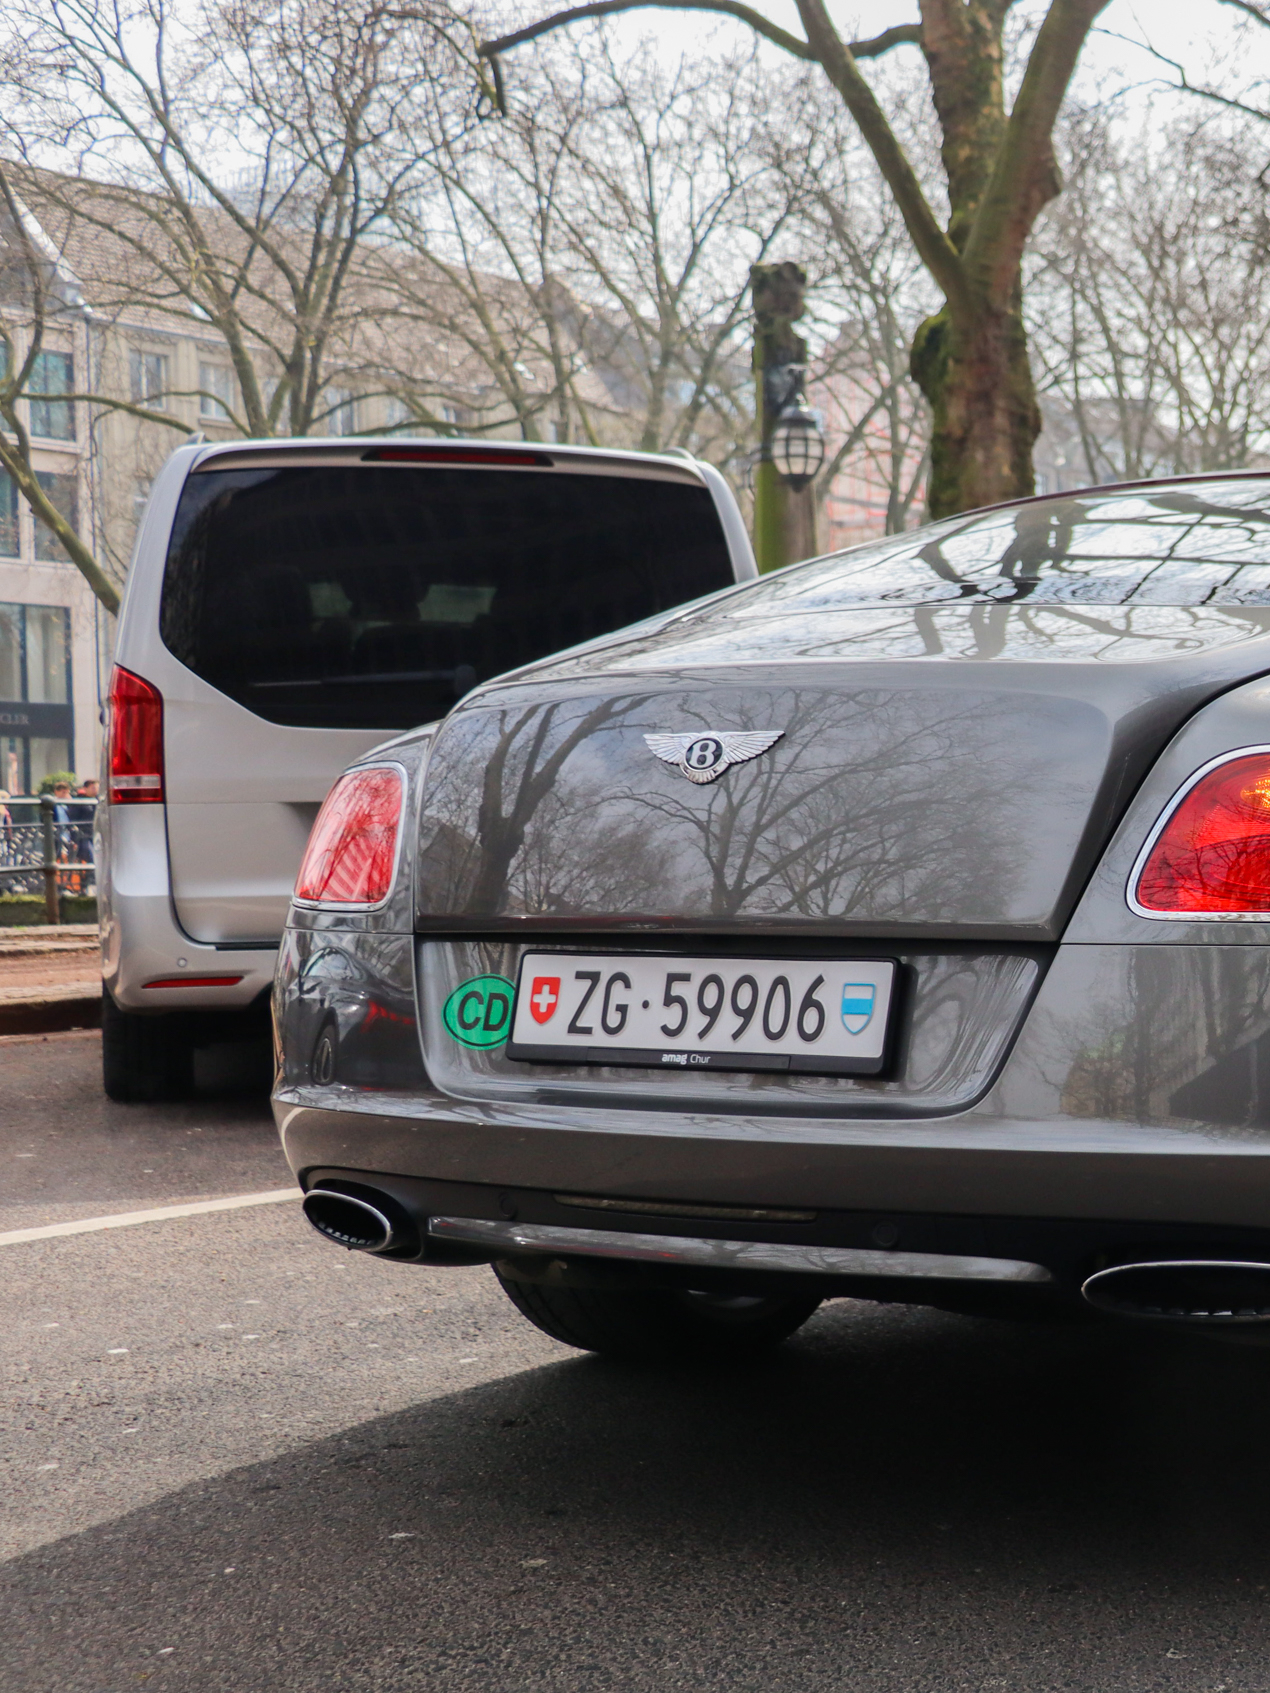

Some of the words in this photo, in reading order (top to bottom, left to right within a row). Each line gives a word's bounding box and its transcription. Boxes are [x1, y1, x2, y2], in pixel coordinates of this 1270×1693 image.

[457, 990, 510, 1032] CD
[661, 1053, 688, 1065] amag
[690, 1054, 711, 1064] Chur
